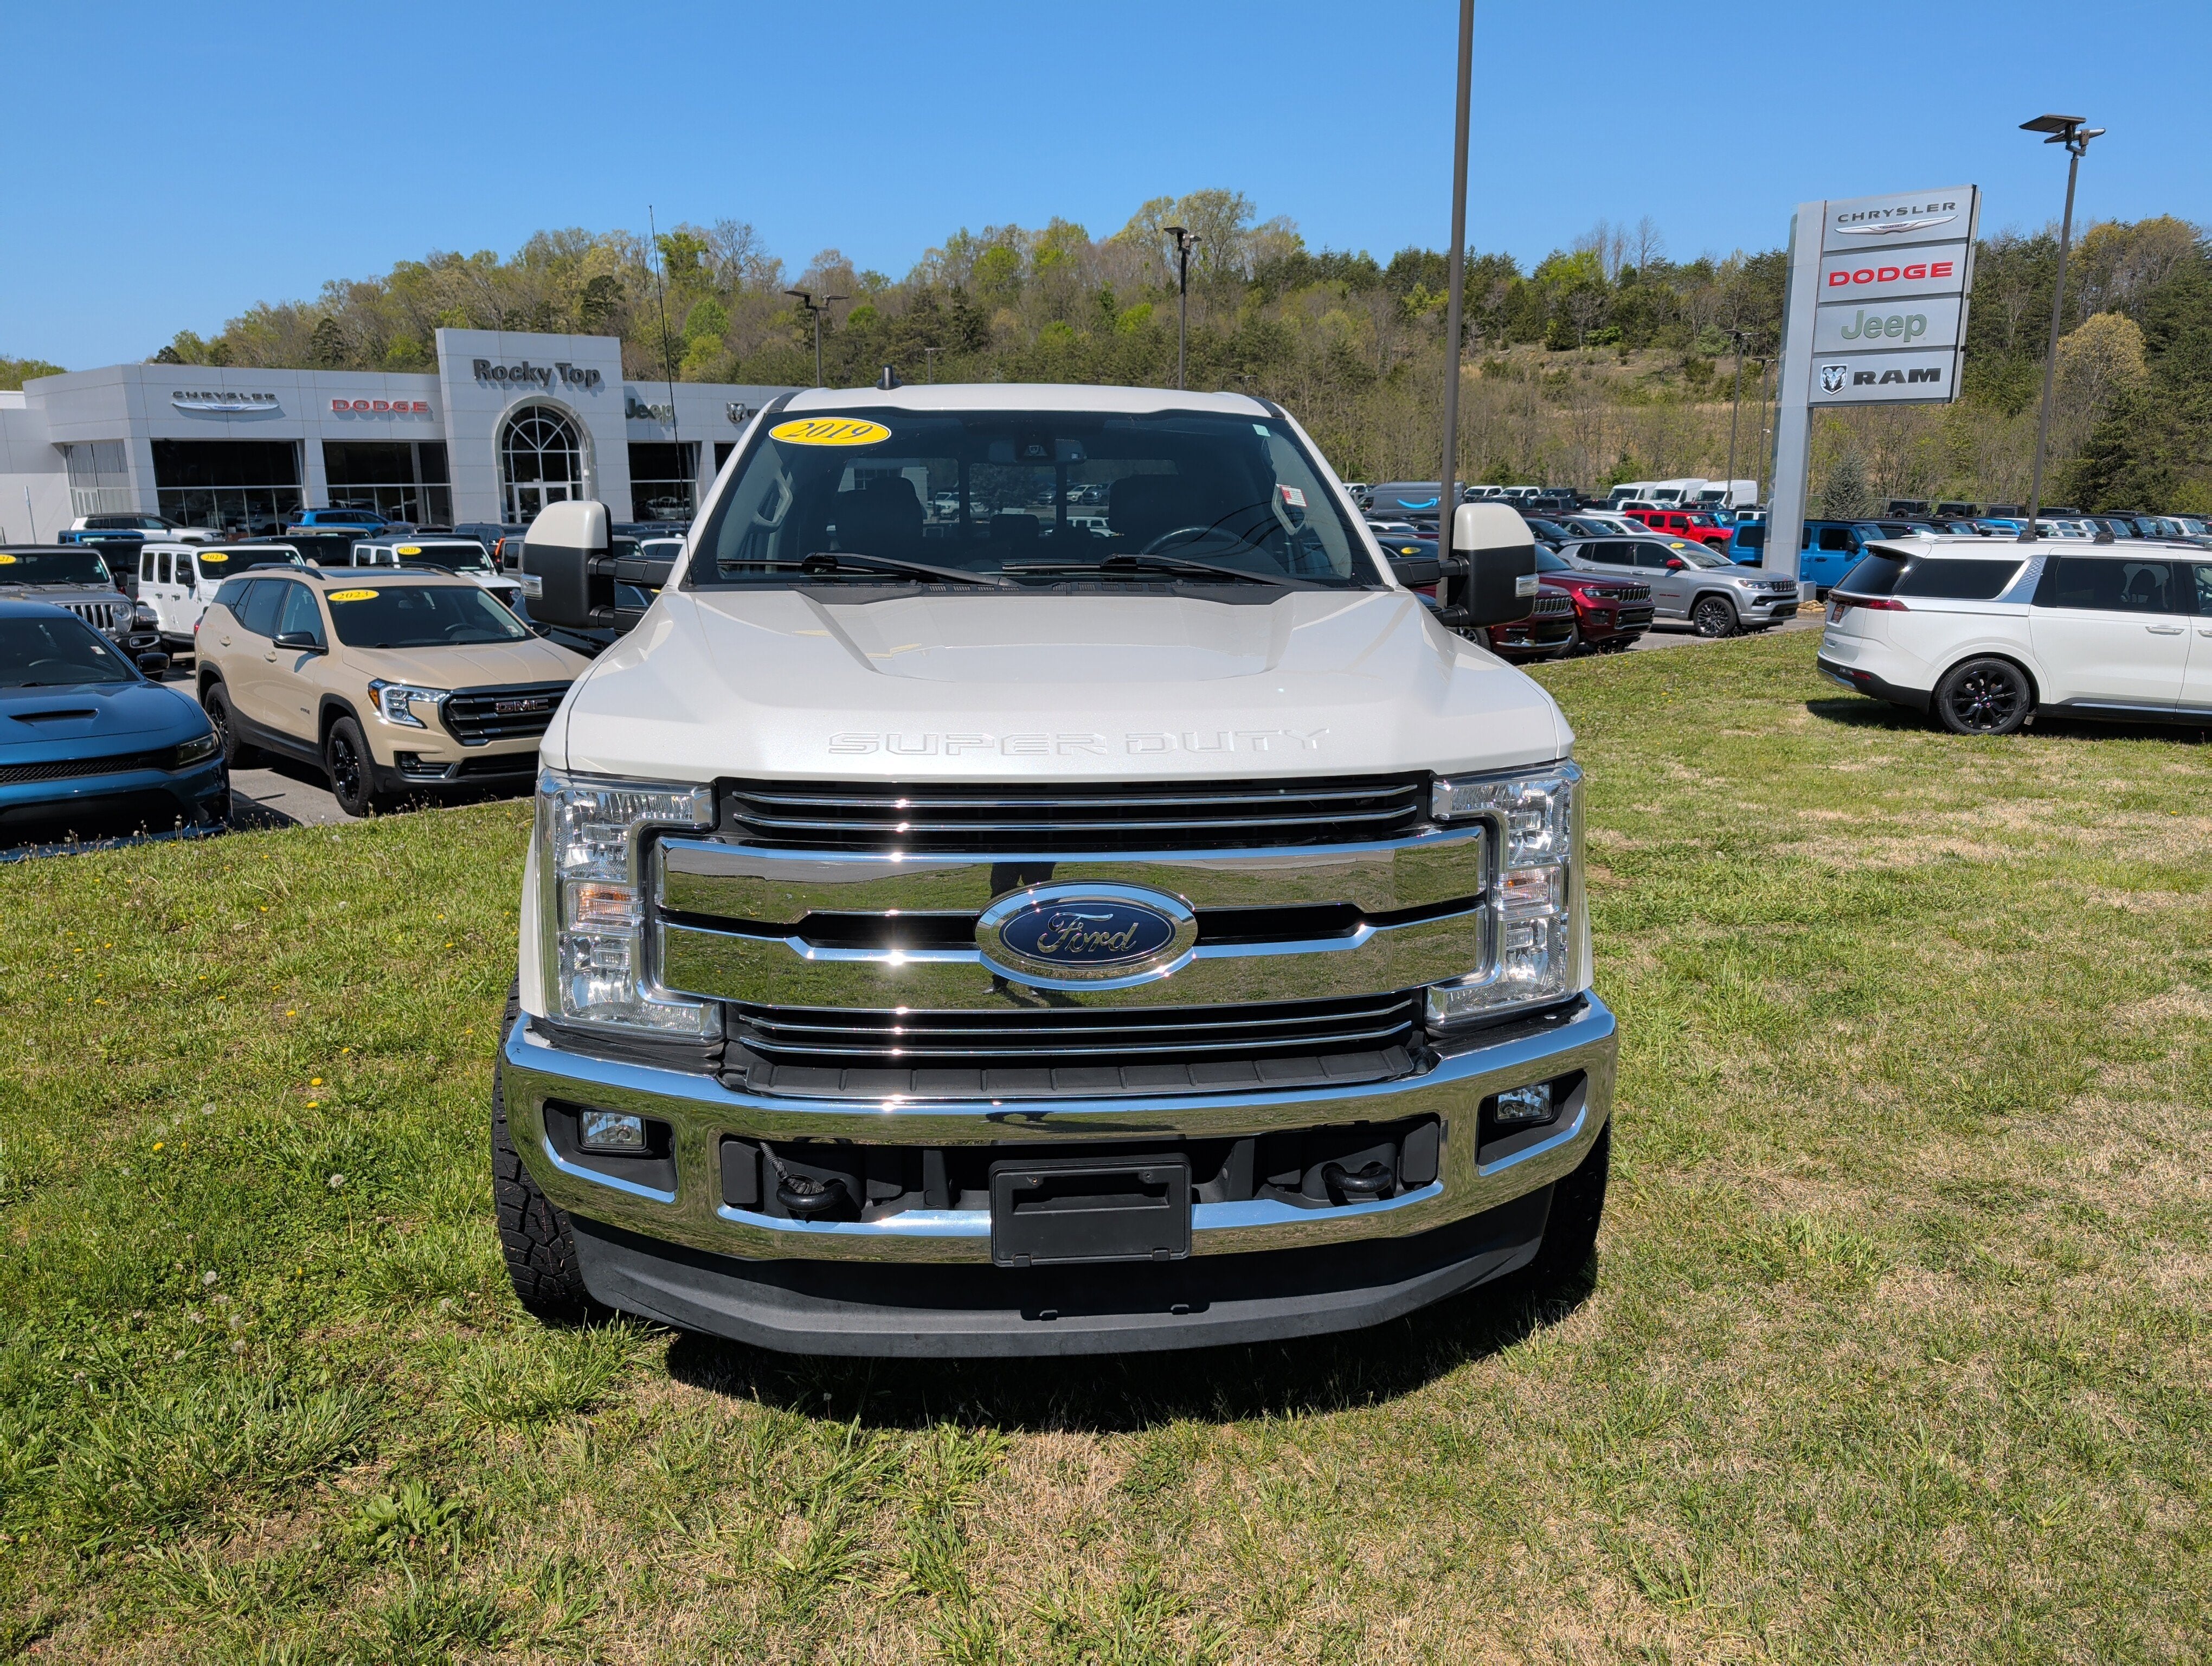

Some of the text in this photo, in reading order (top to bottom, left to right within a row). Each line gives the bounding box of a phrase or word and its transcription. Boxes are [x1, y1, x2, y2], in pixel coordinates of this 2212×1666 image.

[1837, 201, 1956, 223] CHRYSLER
[1828, 261, 1954, 287] DODGE
[1841, 310, 1927, 343] Jeep
[473, 358, 601, 388] Rocky Top
[1853, 367, 1941, 386] RAM
[172, 390, 276, 401] CHRYSLER
[332, 399, 429, 413] DODGE
[625, 398, 673, 425] Jeep
[783, 422, 873, 439] 2019
[496, 698, 549, 713] GMC
[828, 728, 1329, 756] SUPER DUTY
[1037, 912, 1139, 953] Ford
